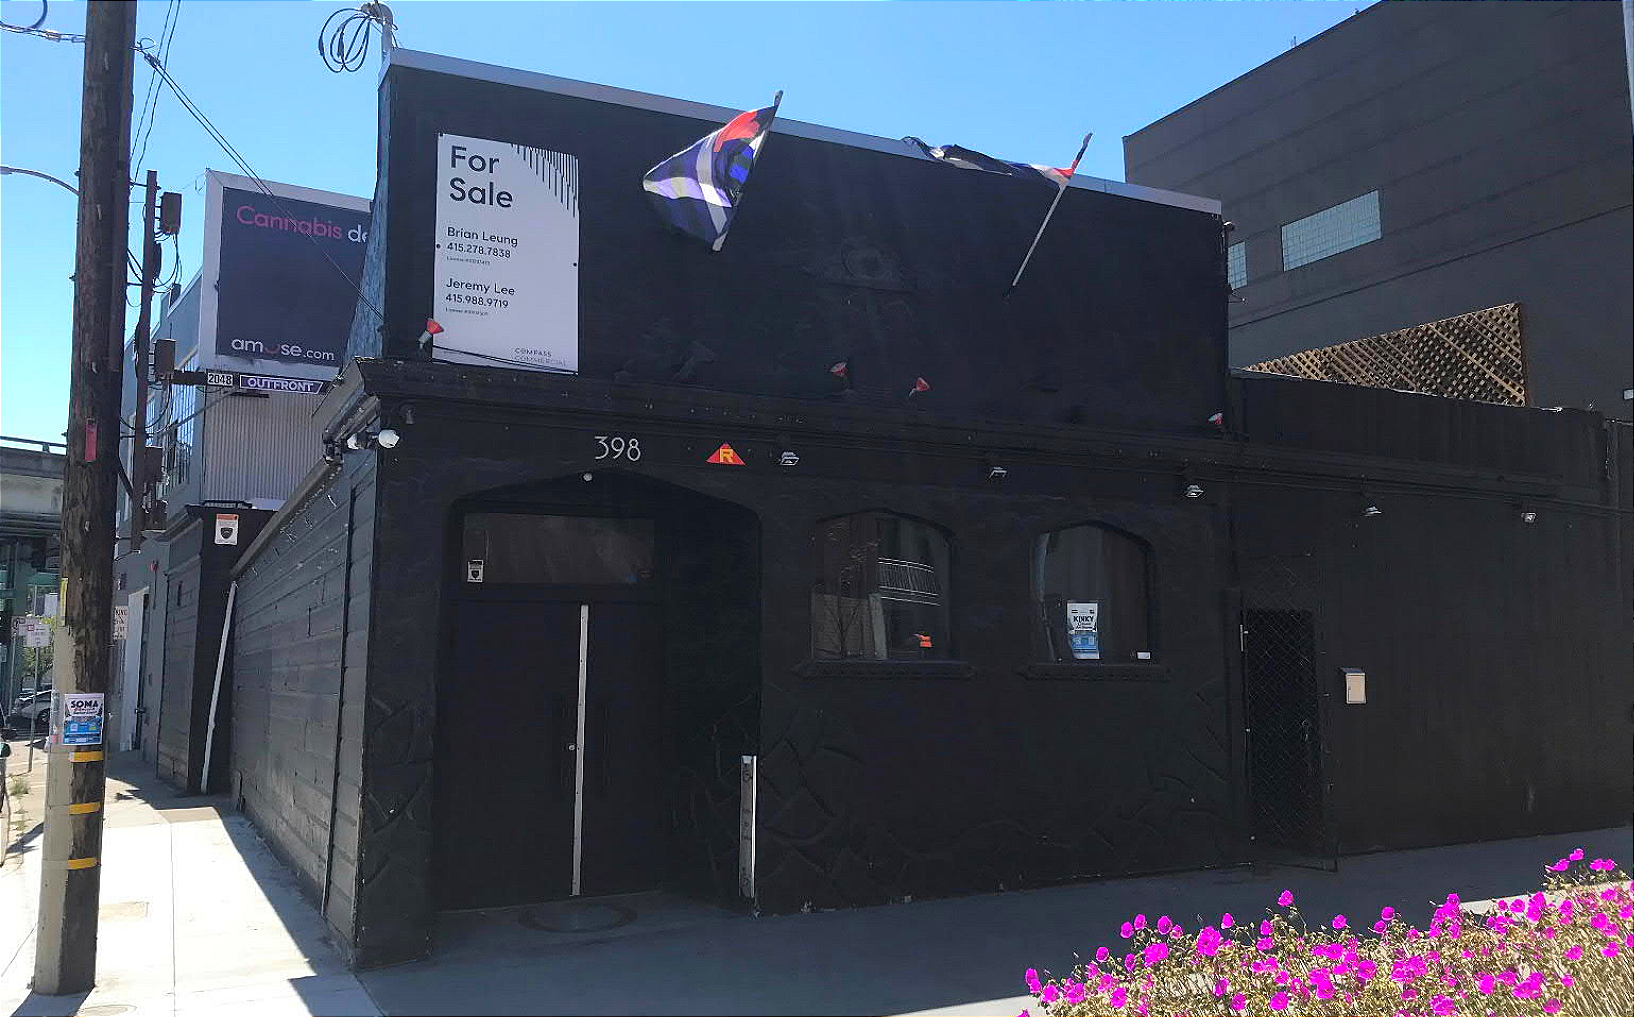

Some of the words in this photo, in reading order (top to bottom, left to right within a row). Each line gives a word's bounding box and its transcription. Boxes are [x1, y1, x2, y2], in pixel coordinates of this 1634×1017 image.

[451, 145, 500, 173] For
[450, 177, 513, 208] Sale
[236, 205, 342, 239] Cannabis
[447, 226, 479, 240] Brian
[482, 231, 518, 248] Leung
[446, 242, 511, 259] 415.278.7838
[446, 278, 490, 294] Jeremy
[494, 282, 515, 296] Lee
[445, 293, 509, 309] 415.988.9719
[514, 347, 552, 358] COMPASS
[208, 373, 233, 385] 2048
[247, 377, 314, 392] OUTFRONT
[594, 435, 642, 462] 398
[719, 448, 734, 463] R
[70, 700, 98, 708] SOMA
